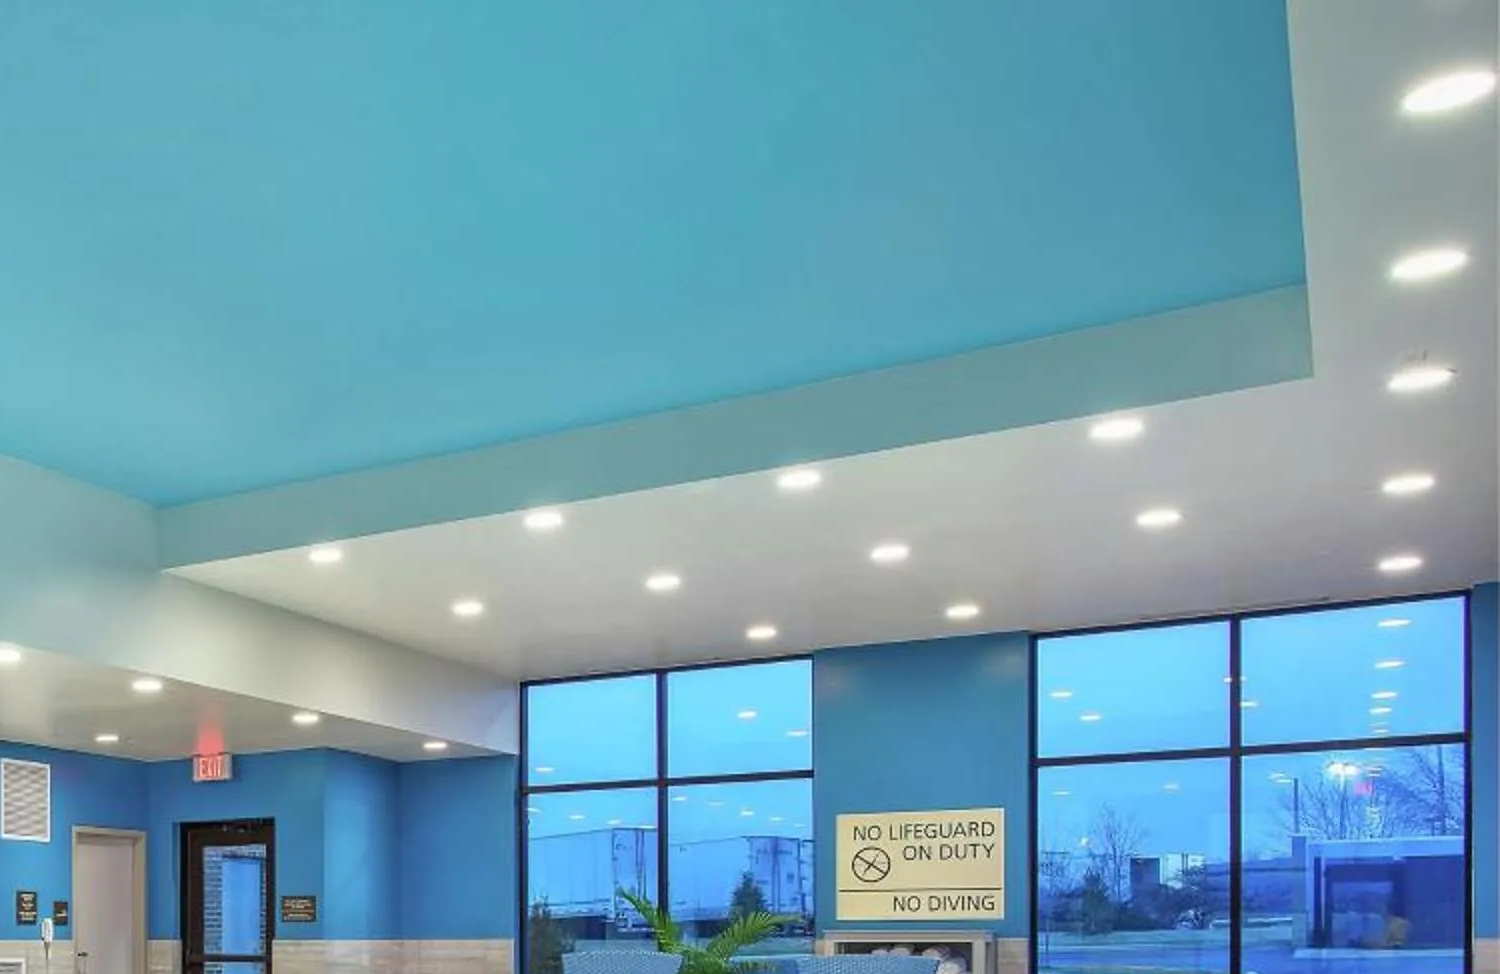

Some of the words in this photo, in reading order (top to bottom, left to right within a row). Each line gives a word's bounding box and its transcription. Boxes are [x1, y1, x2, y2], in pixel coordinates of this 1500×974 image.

[199, 756, 224, 778] EXIT
[853, 825, 882, 841] NO
[888, 821, 996, 841] LIFEGUARD
[902, 845, 932, 861] ON
[939, 843, 996, 861] DUTY
[893, 896, 922, 912] NO
[928, 895, 996, 912] DIVING
